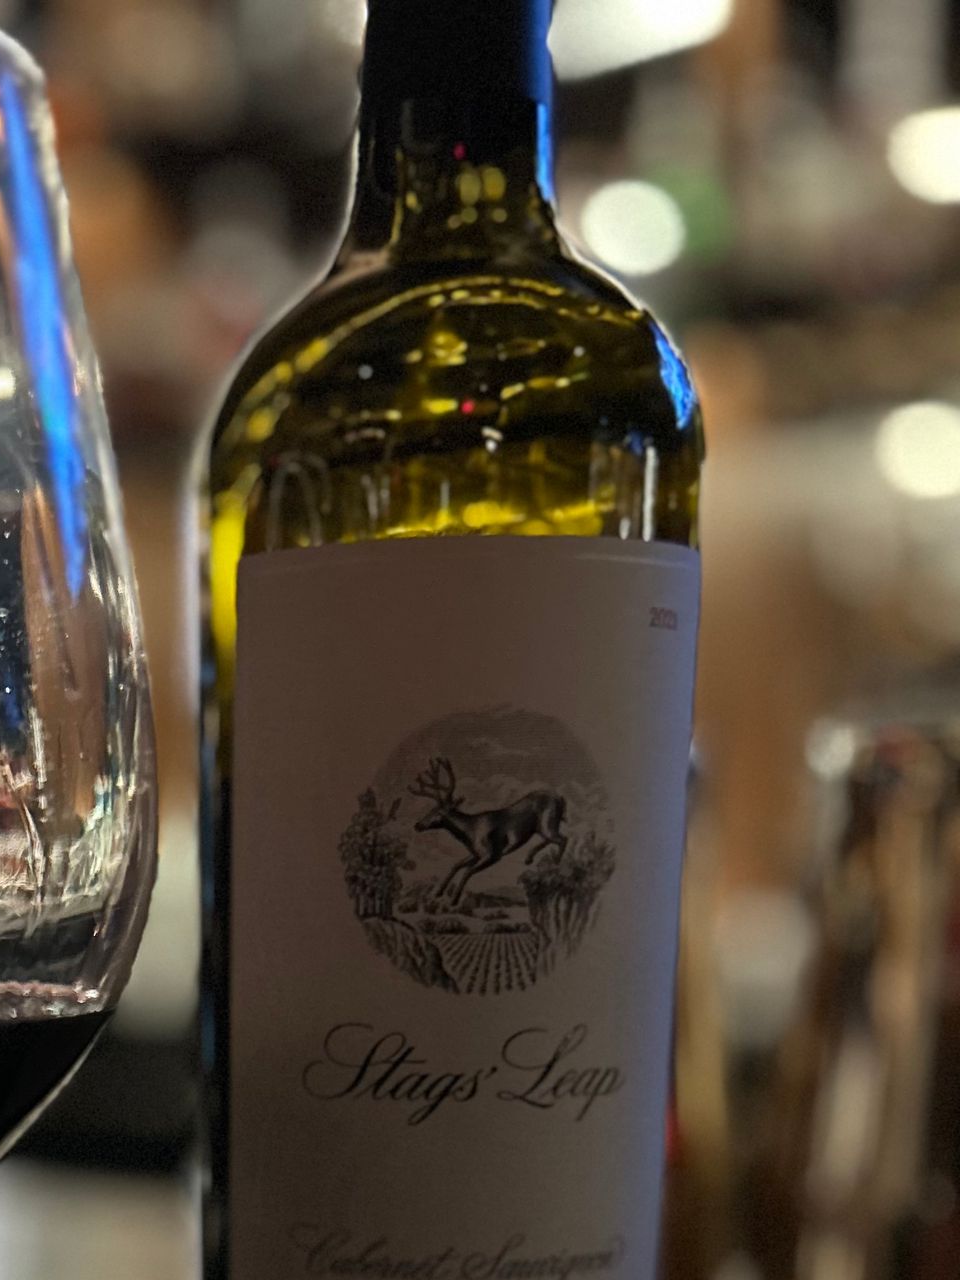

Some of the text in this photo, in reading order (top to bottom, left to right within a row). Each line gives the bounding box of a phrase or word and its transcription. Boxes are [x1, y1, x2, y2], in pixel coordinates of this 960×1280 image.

[302, 1021, 625, 1127] Stags' Leap
[288, 1221, 456, 1280] Cabernet
